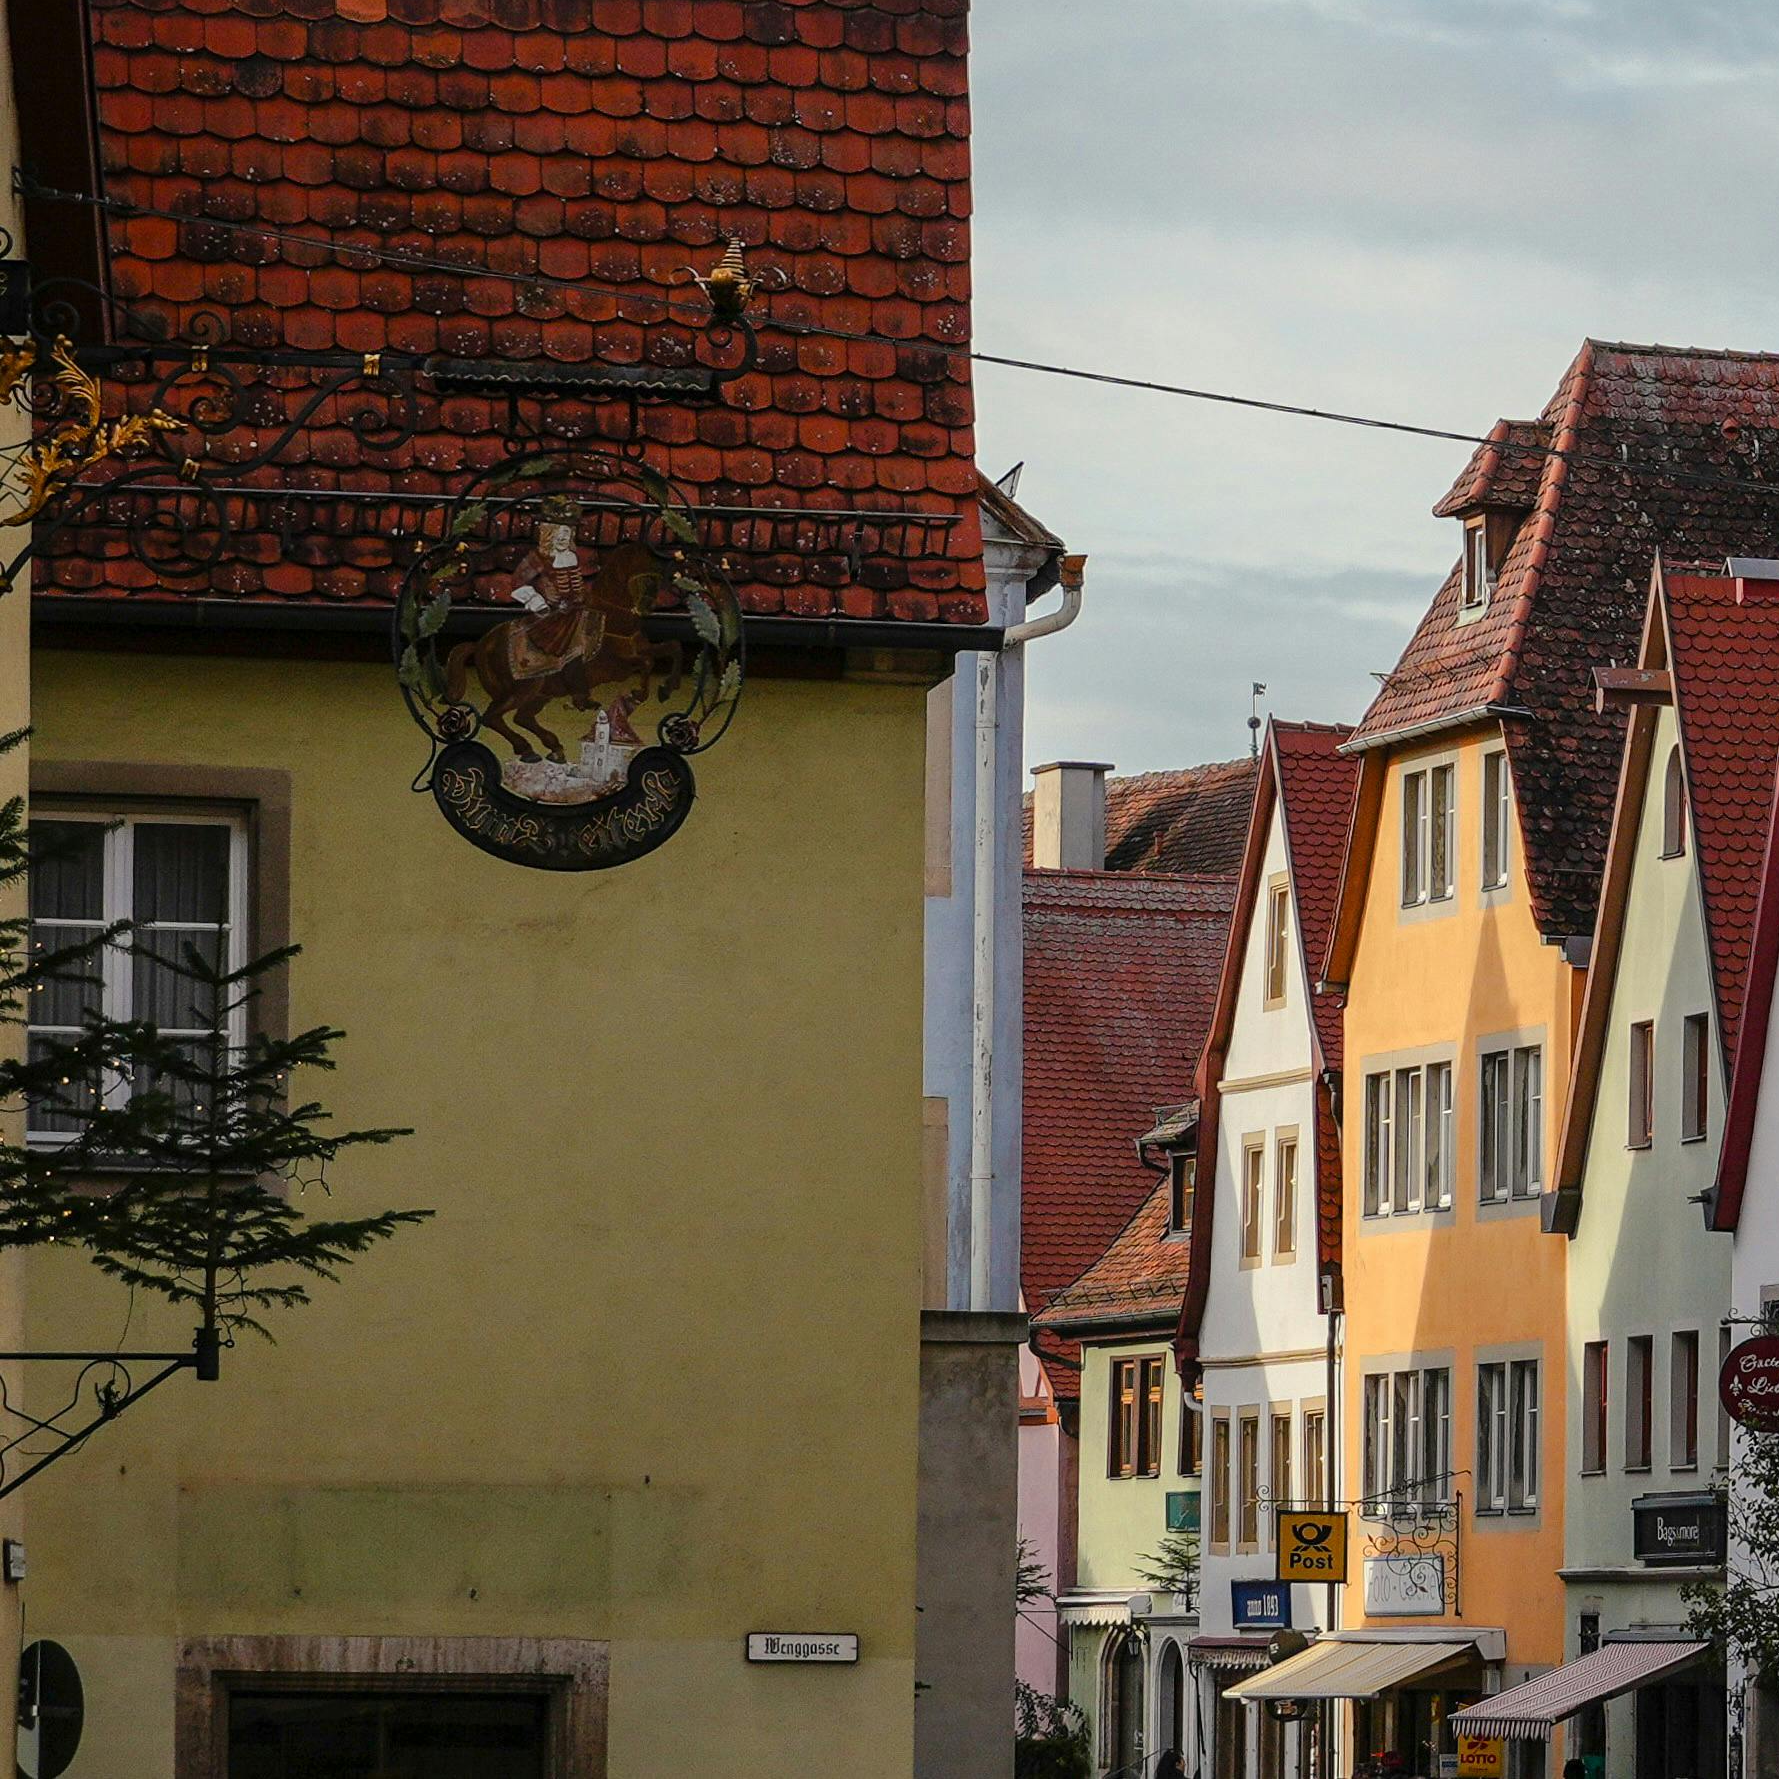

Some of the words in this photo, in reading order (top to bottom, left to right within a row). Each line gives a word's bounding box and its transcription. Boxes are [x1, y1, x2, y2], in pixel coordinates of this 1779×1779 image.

[1290, 1552, 1333, 1569] Post
[764, 1637, 840, 1658] Wenggasse
[1461, 1754, 1497, 1764] LOTTO
